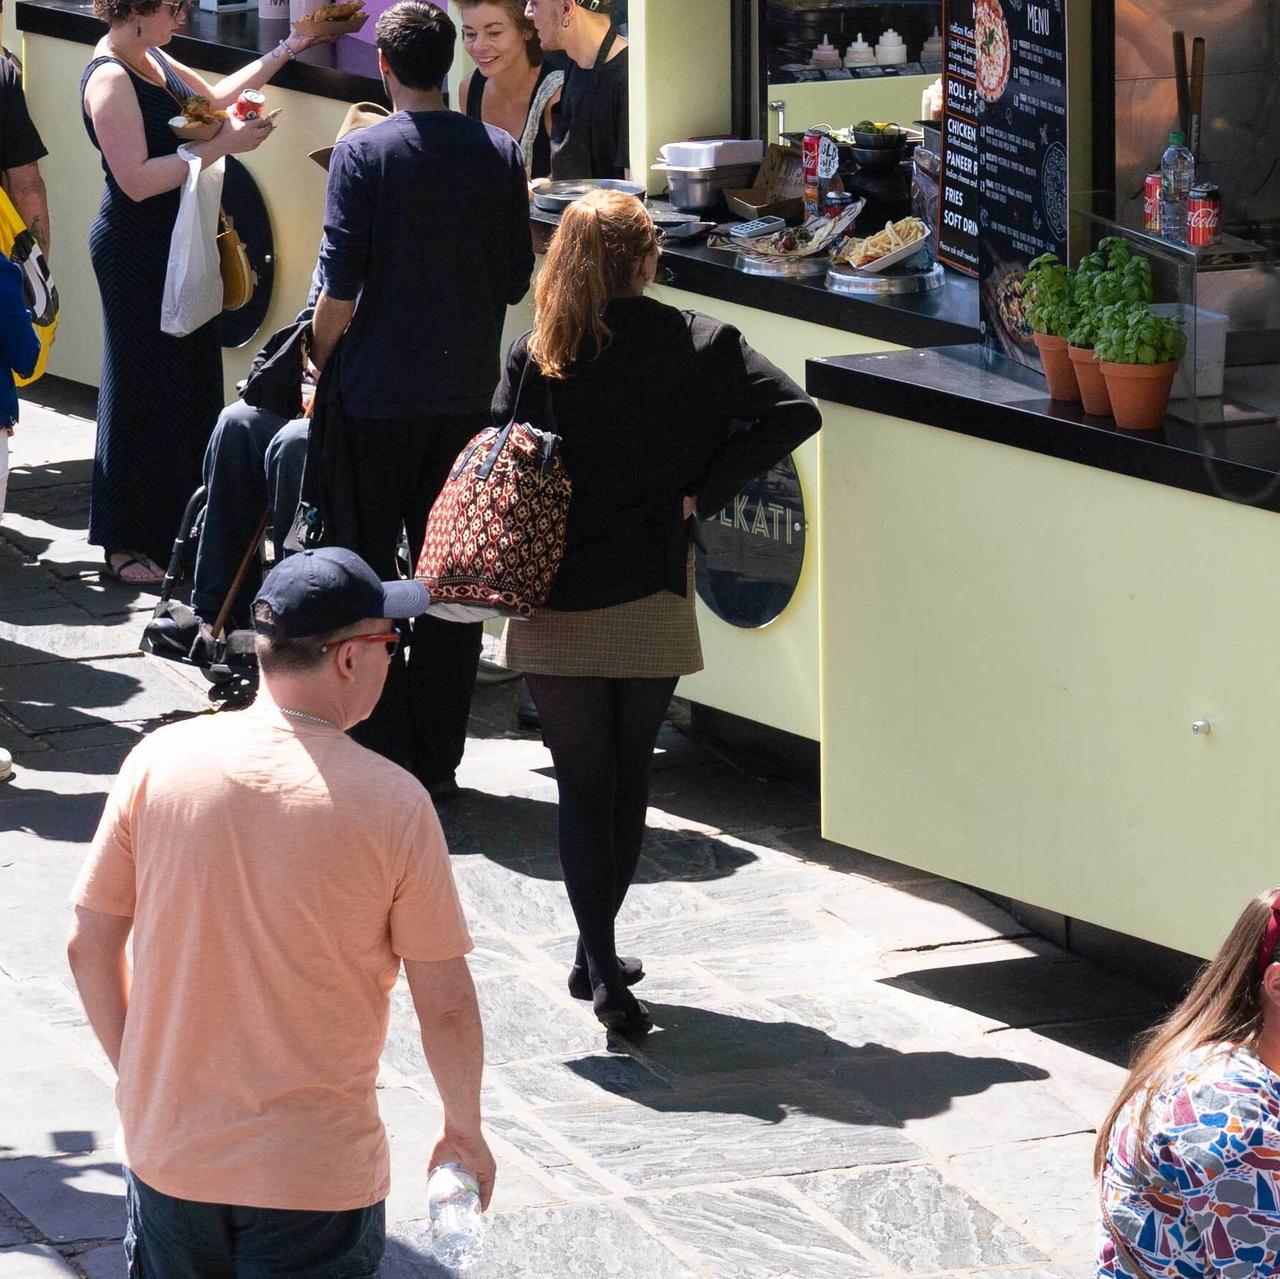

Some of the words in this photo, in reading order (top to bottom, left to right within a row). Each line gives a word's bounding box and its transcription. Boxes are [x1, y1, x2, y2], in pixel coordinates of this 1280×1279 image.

[1026, 2, 1050, 36] MENU
[948, 79, 966, 100] ROLL
[947, 118, 977, 143] CHICKEN
[946, 150, 972, 173] PANEER
[944, 186, 964, 207] FRIES
[943, 209, 962, 230] SOFT
[1190, 207, 1219, 228] Cola
[706, 493, 793, 545] LKATI
